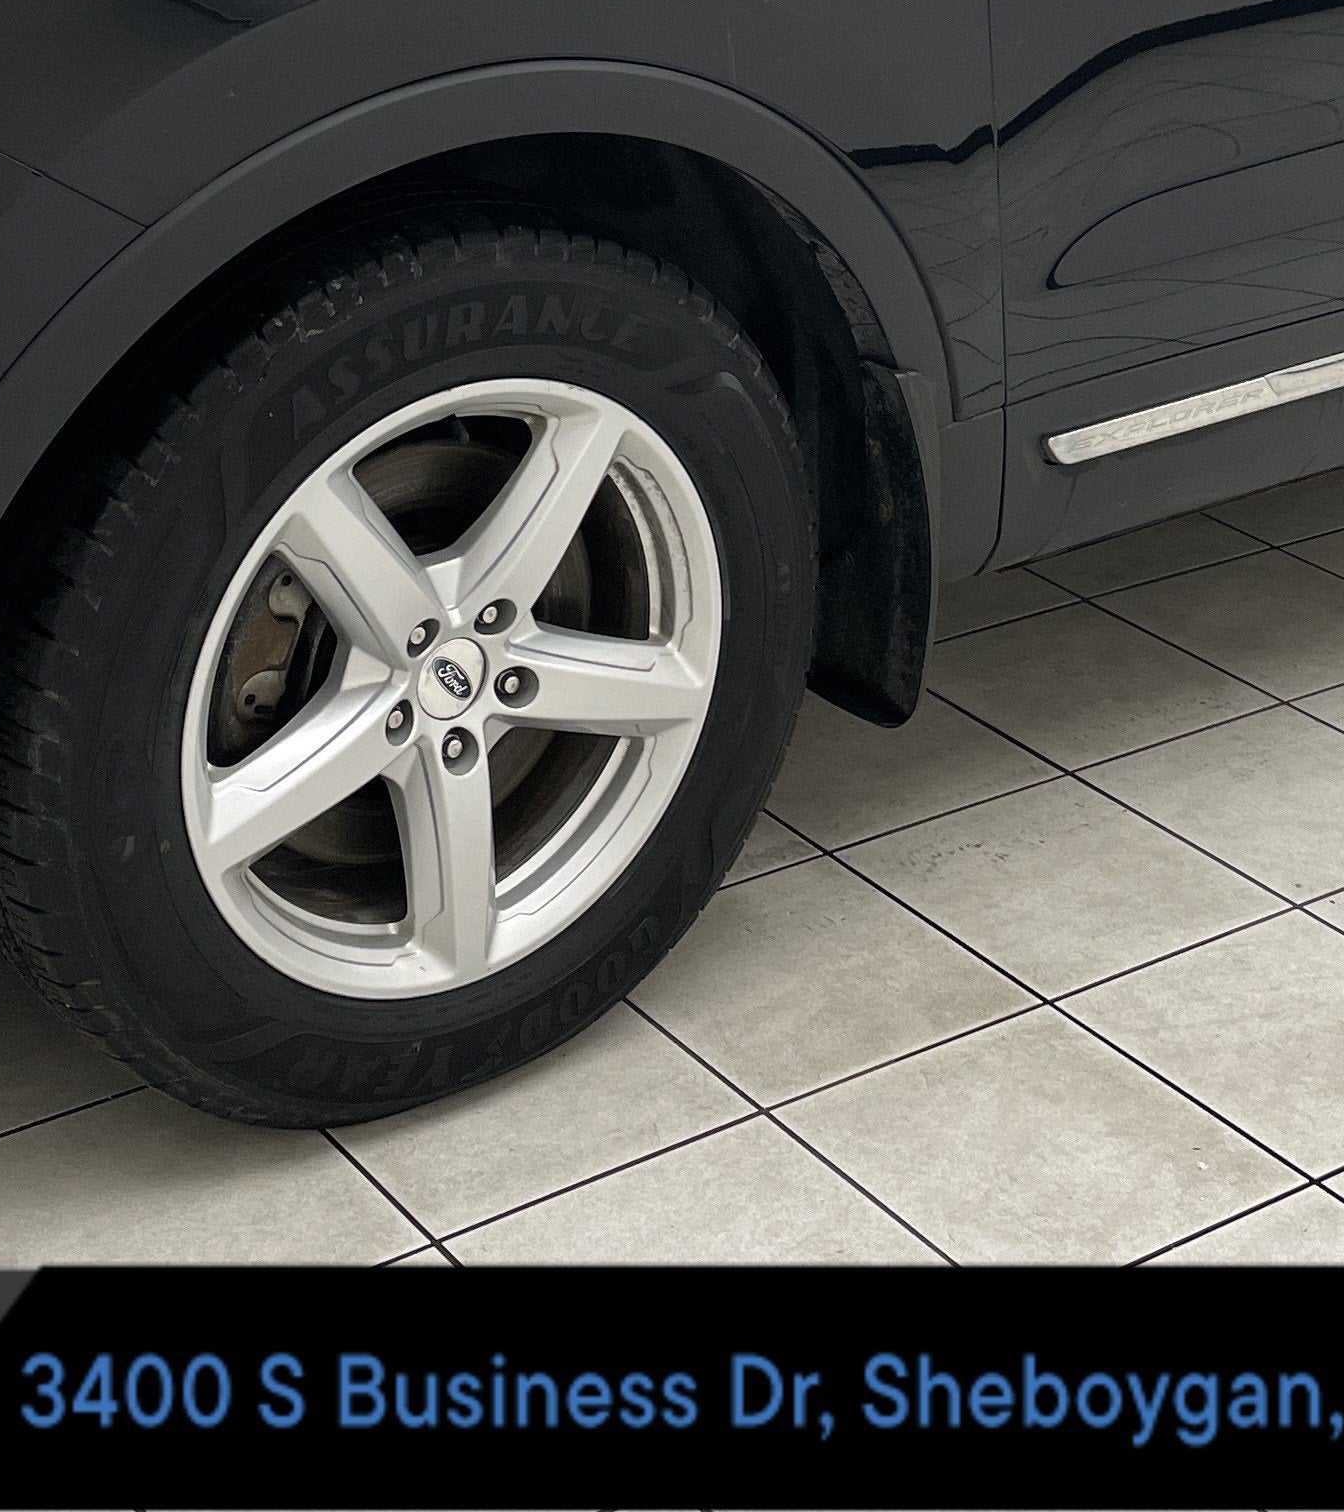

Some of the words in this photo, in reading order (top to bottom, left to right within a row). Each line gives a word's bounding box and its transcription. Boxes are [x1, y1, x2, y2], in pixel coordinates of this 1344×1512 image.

[290, 292, 652, 441] ASSURANCE
[1068, 387, 1266, 452] EXPLORER
[436, 663, 470, 697] Ford
